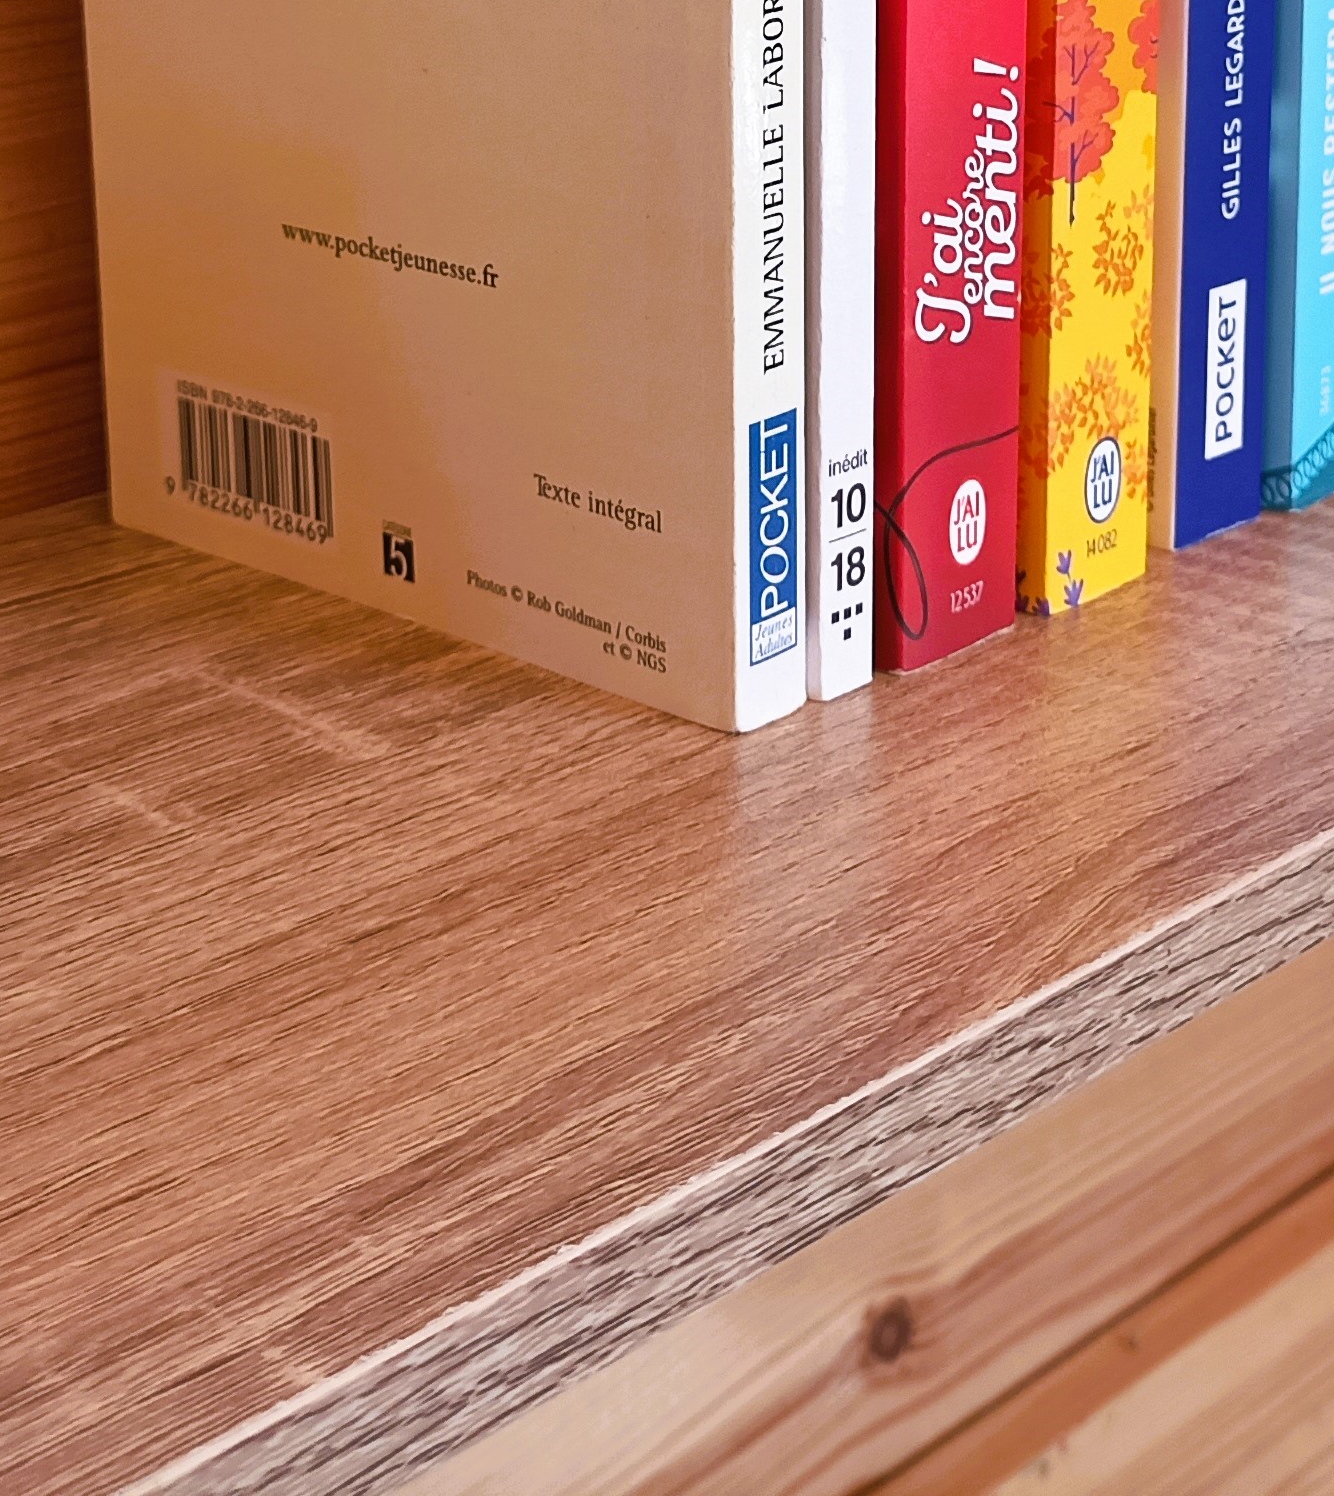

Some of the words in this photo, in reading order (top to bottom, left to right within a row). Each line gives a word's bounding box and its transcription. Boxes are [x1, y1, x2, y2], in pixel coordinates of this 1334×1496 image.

[1220, 117, 1242, 220] GILLES
[763, 123, 784, 375] EMMANUELLE
[963, 148, 984, 304] encore
[281, 222, 499, 288] www.pocketjeunesse.fr
[914, 198, 971, 343] J'ai
[828, 449, 868, 477] inédit
[1091, 451, 1115, 483] J'AI
[533, 473, 580, 508] Texte
[588, 491, 662, 533] intégral
[831, 482, 866, 528] 10
[954, 491, 979, 525] J'AI
[1093, 479, 1113, 509] LU
[760, 419, 788, 617] POCKET
[957, 521, 977, 553] LU
[831, 545, 865, 592] 18
[467, 569, 507, 597] Photos
[527, 590, 551, 613] Rob
[555, 601, 612, 634] Goldman
[625, 625, 667, 653] Corbis
[951, 581, 984, 613] 12537
[636, 651, 667, 674] NGS
